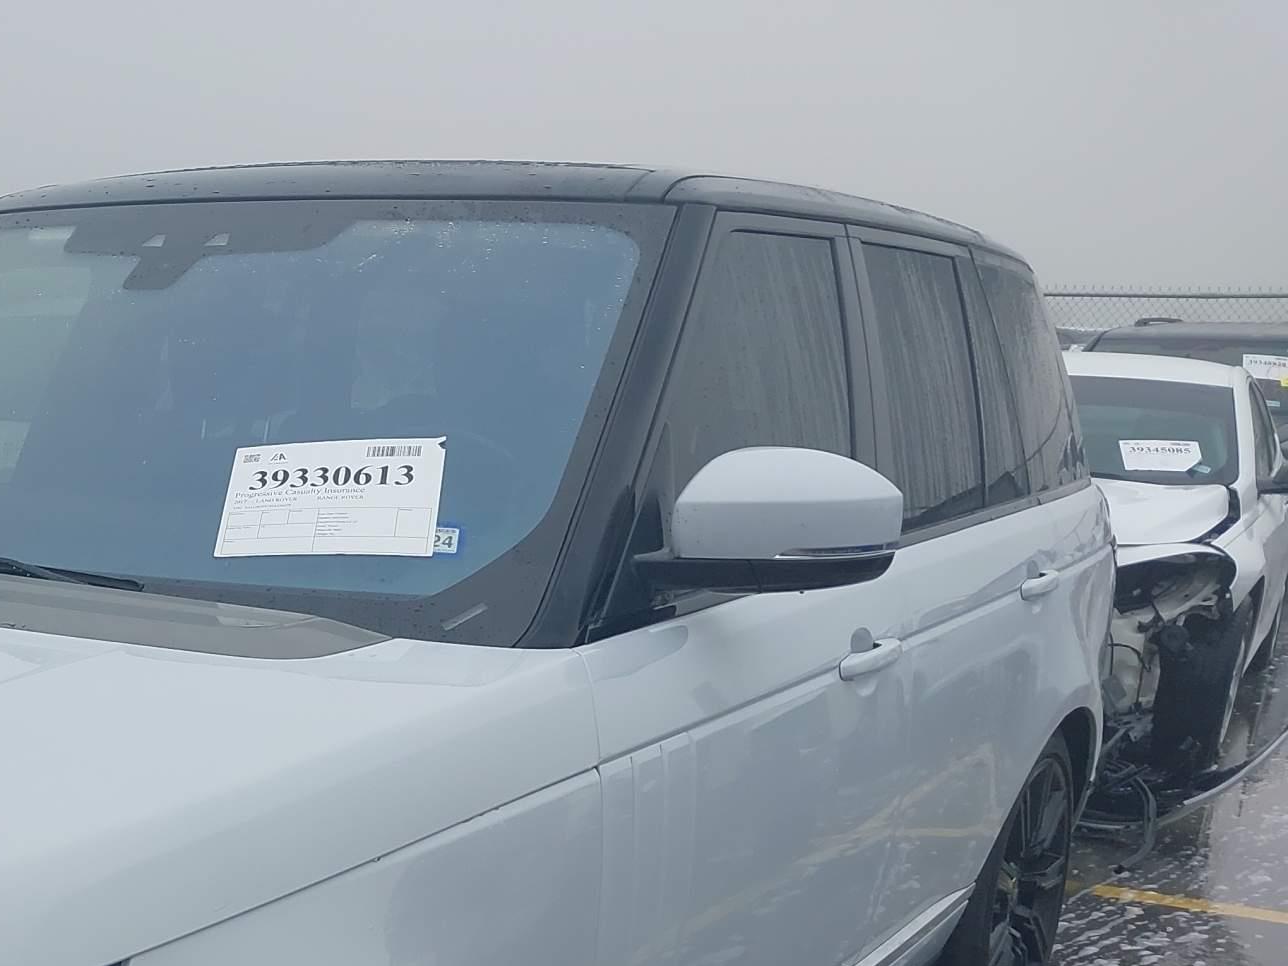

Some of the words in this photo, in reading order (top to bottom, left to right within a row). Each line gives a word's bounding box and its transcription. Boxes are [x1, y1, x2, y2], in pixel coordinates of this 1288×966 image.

[248, 465, 414, 490] 39330613
[235, 490, 283, 499] Progressive
[285, 487, 322, 496] Casualty
